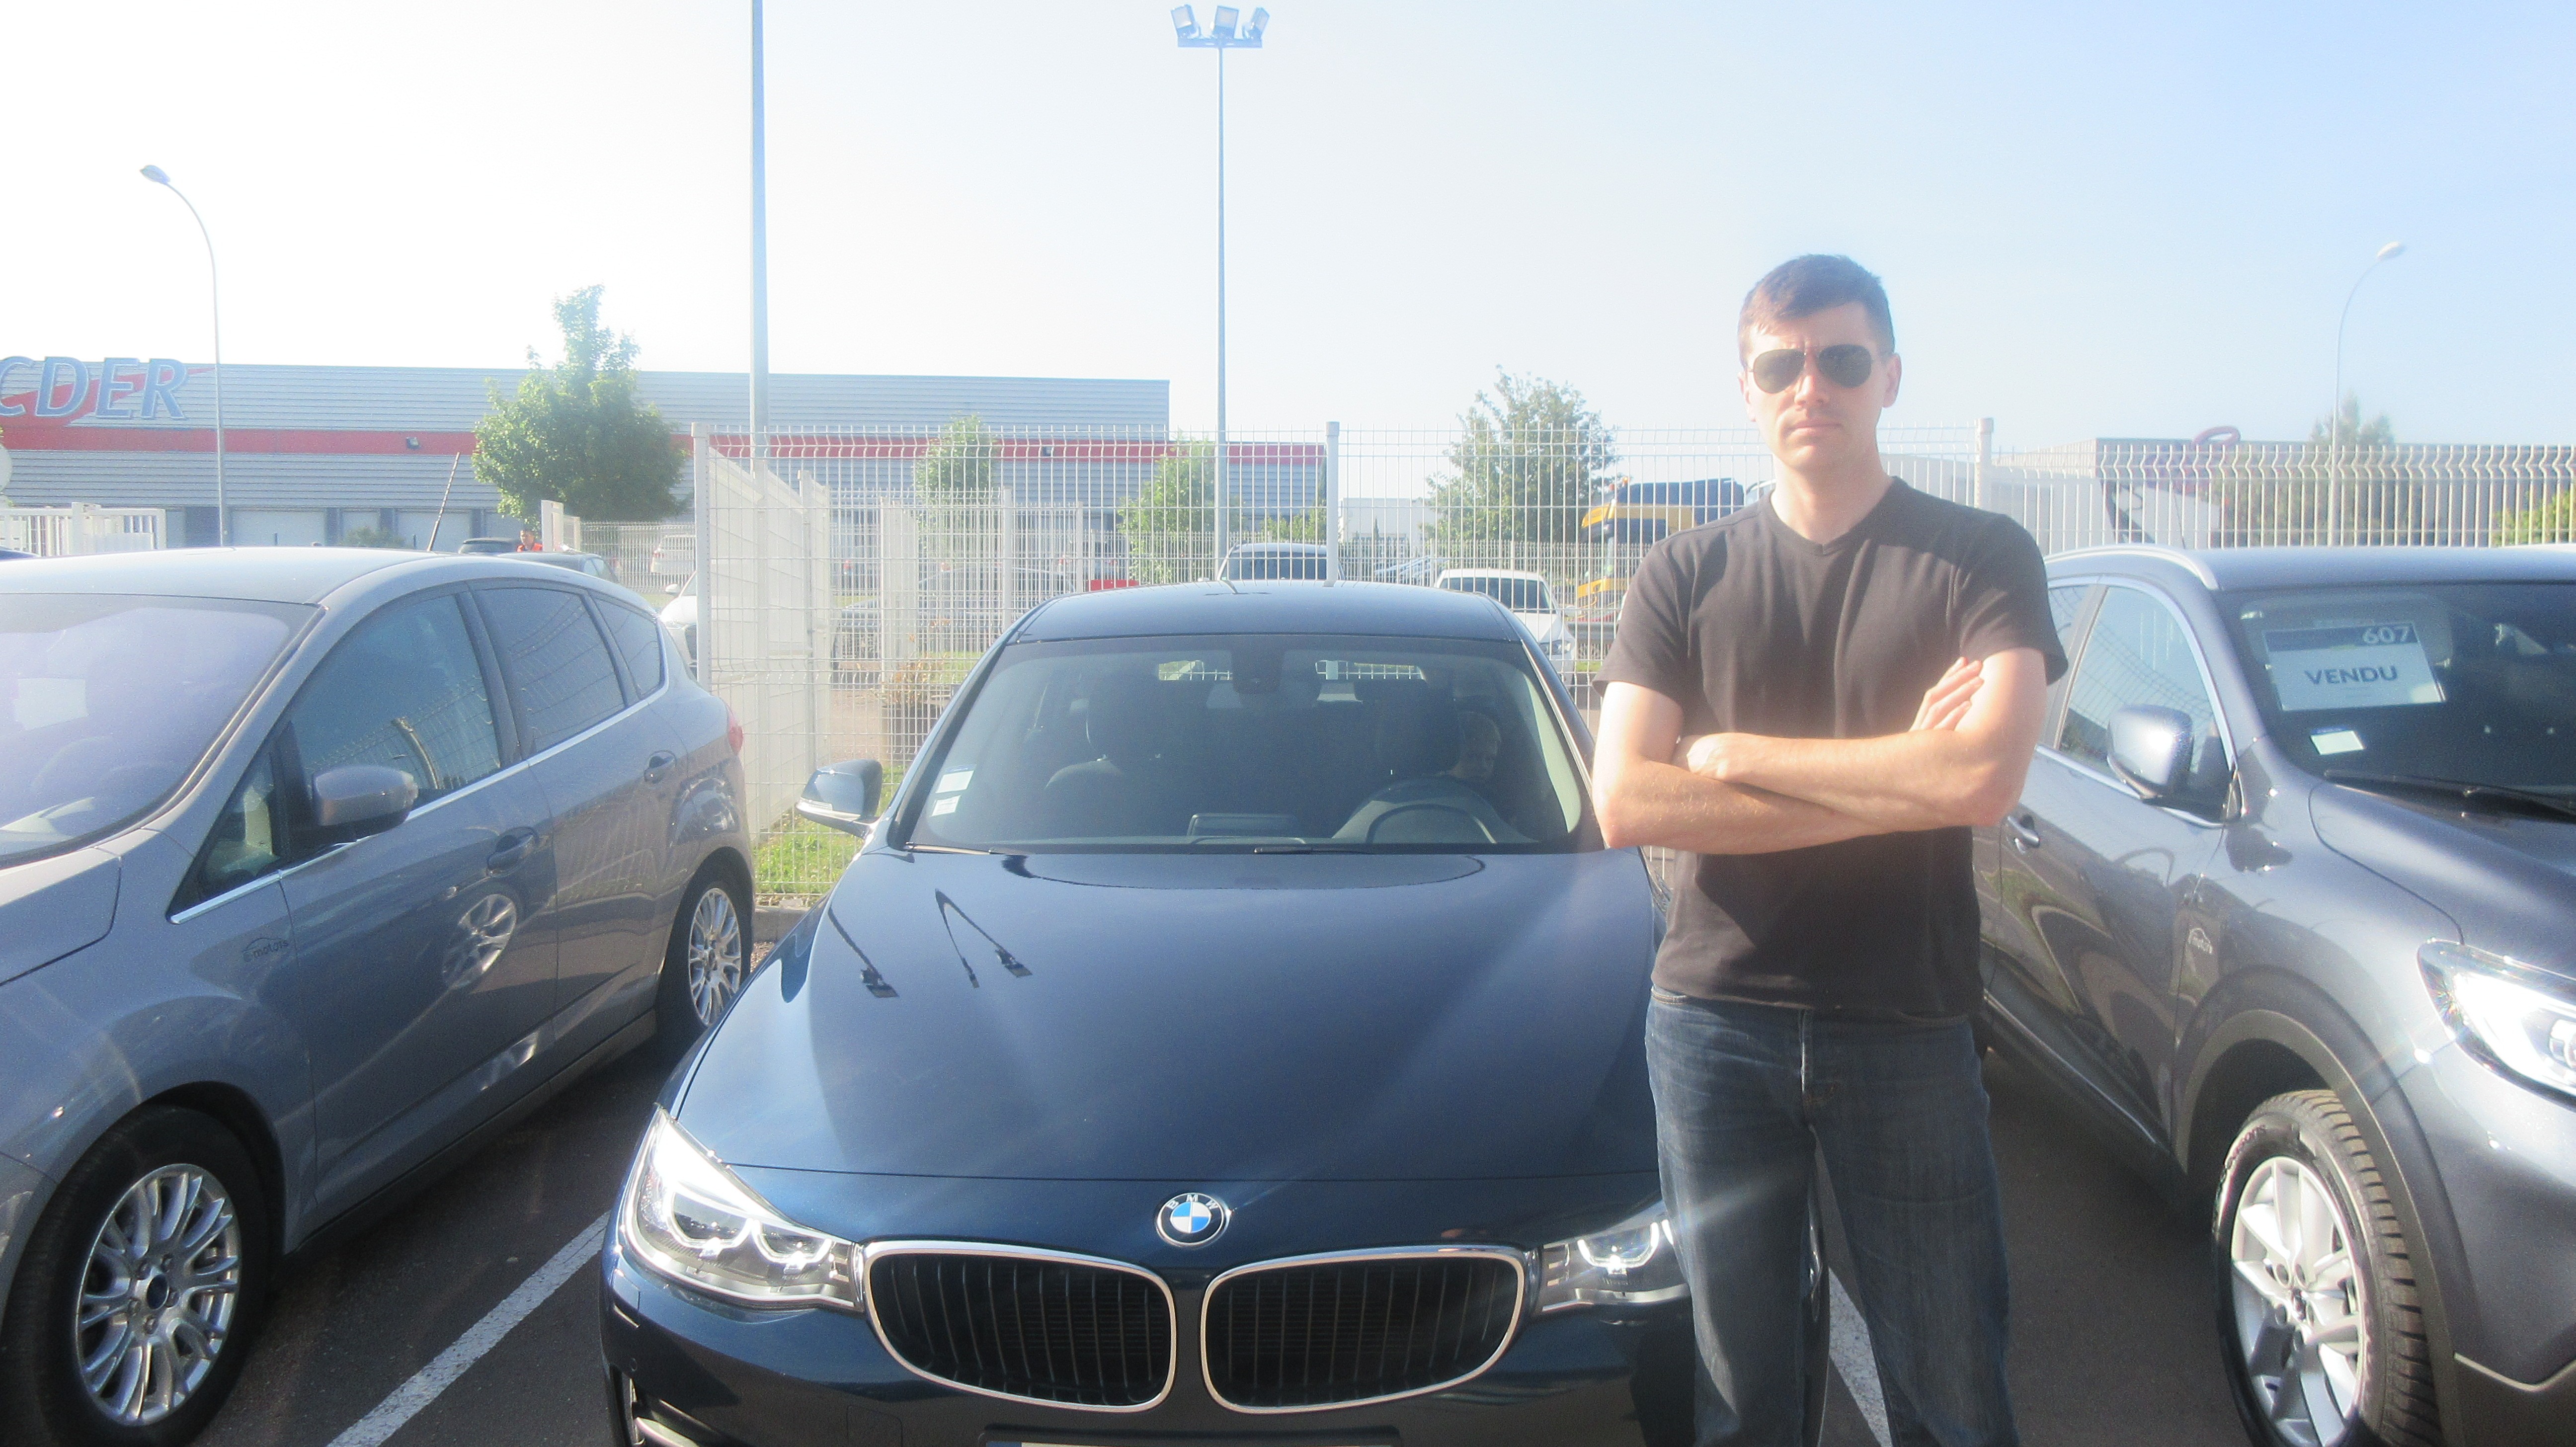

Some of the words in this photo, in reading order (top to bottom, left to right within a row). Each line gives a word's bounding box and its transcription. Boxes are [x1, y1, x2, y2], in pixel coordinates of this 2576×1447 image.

[0, 356, 188, 419] CDER
[2363, 626, 2410, 644] 607
[2305, 666, 2397, 685] VENDU
[1167, 1194, 1218, 1208] BMW
